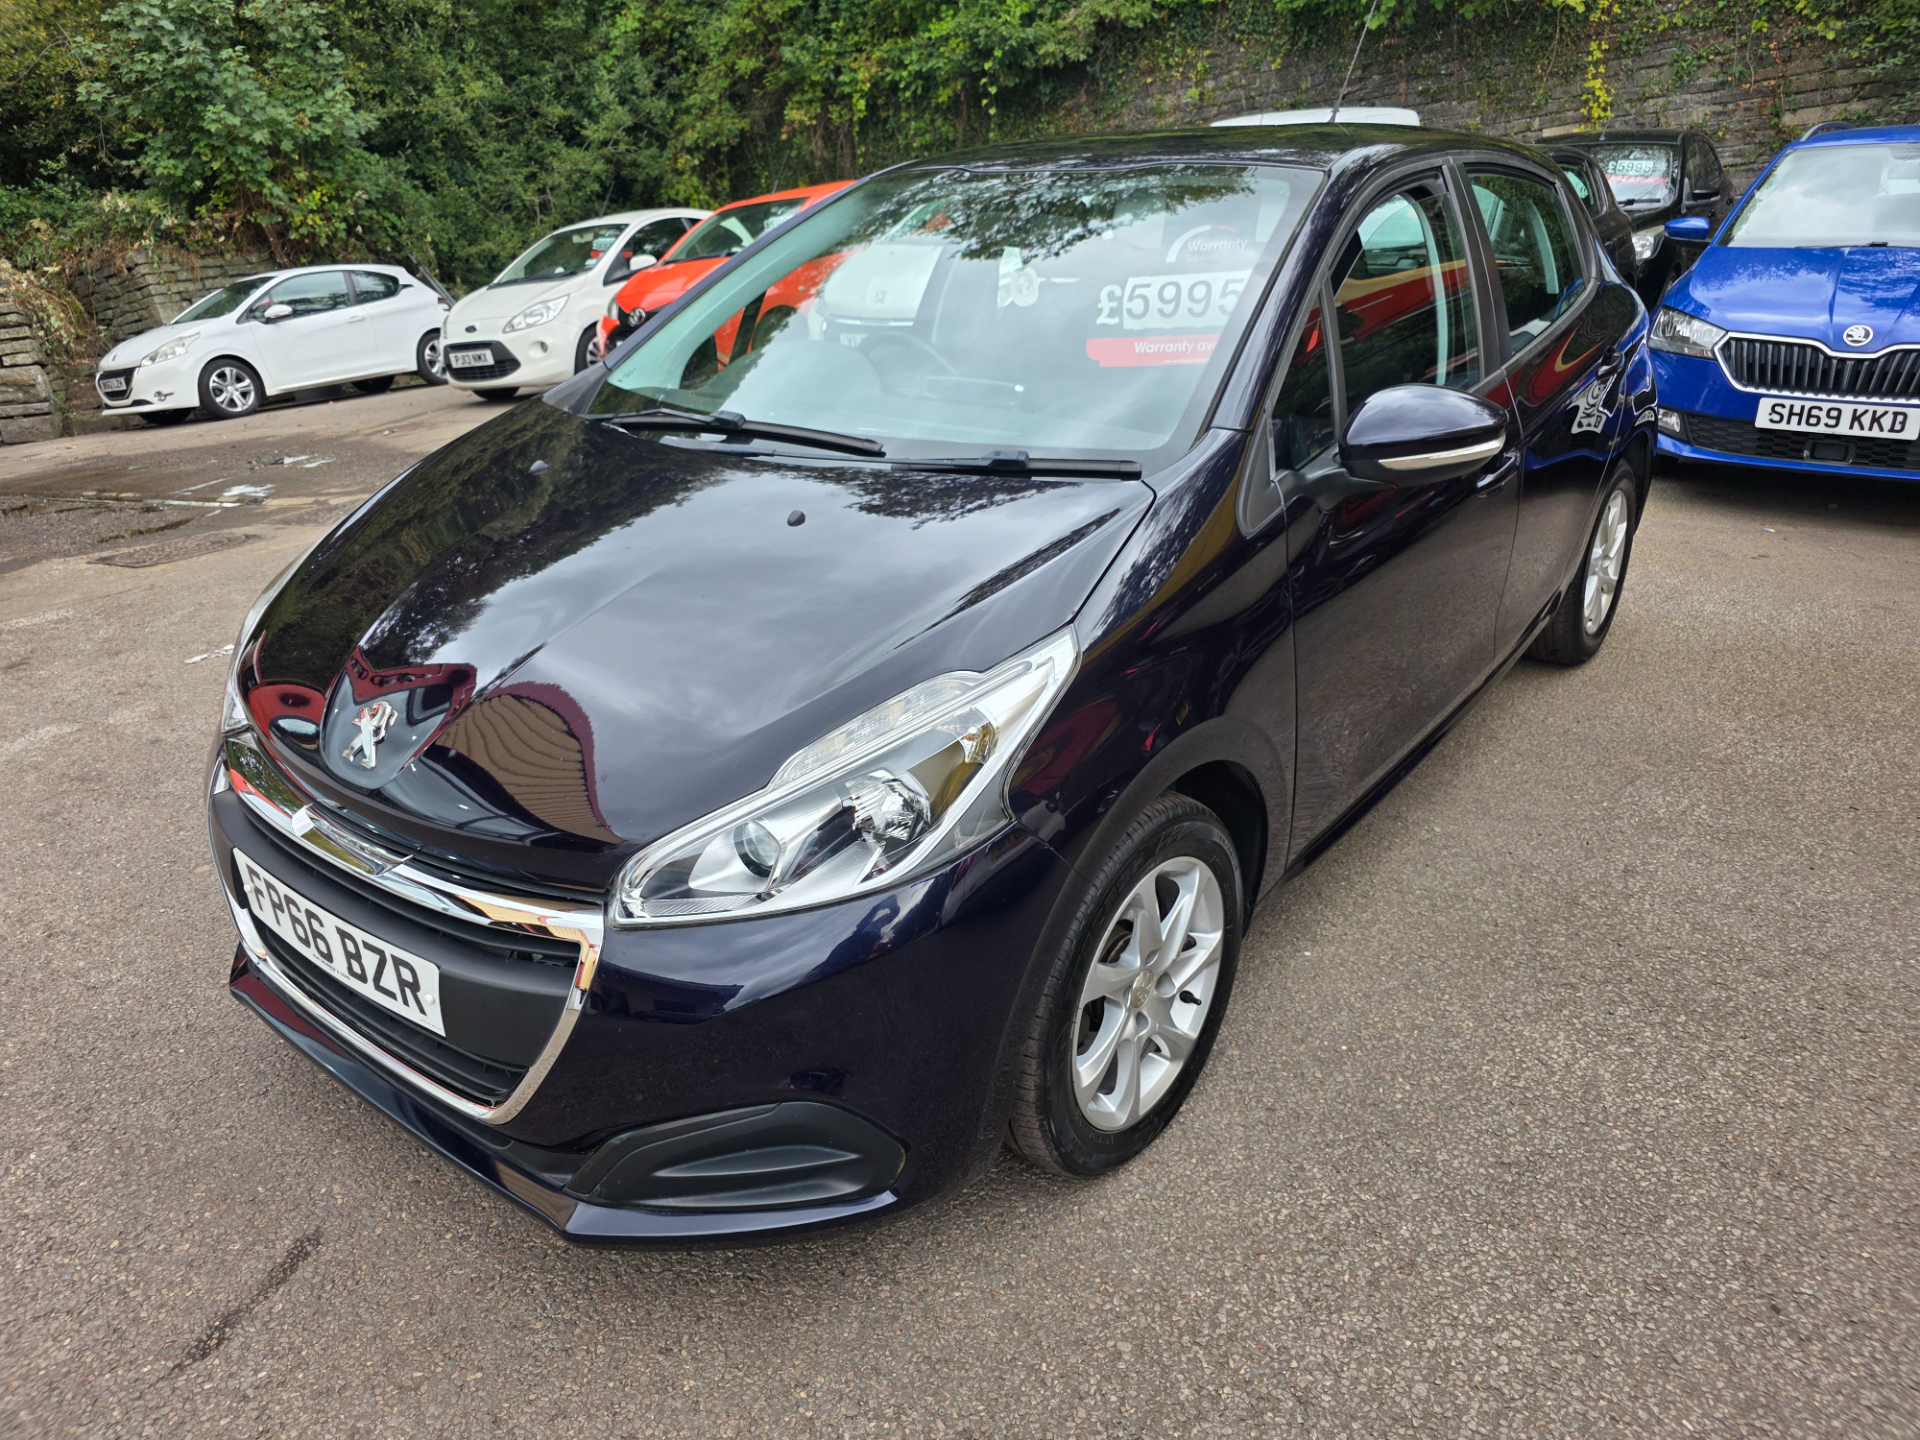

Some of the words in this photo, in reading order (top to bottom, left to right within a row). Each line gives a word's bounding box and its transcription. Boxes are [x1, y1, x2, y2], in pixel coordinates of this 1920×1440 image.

[1606, 160, 1652, 174] £5995
[1188, 239, 1248, 252] Warranty
[1096, 278, 1246, 325] £5995
[1134, 340, 1195, 355] Warranty
[1768, 403, 1842, 428] SH69
[1849, 408, 1909, 433] KKD
[246, 863, 334, 964] FP66
[334, 925, 428, 1017] BZR
